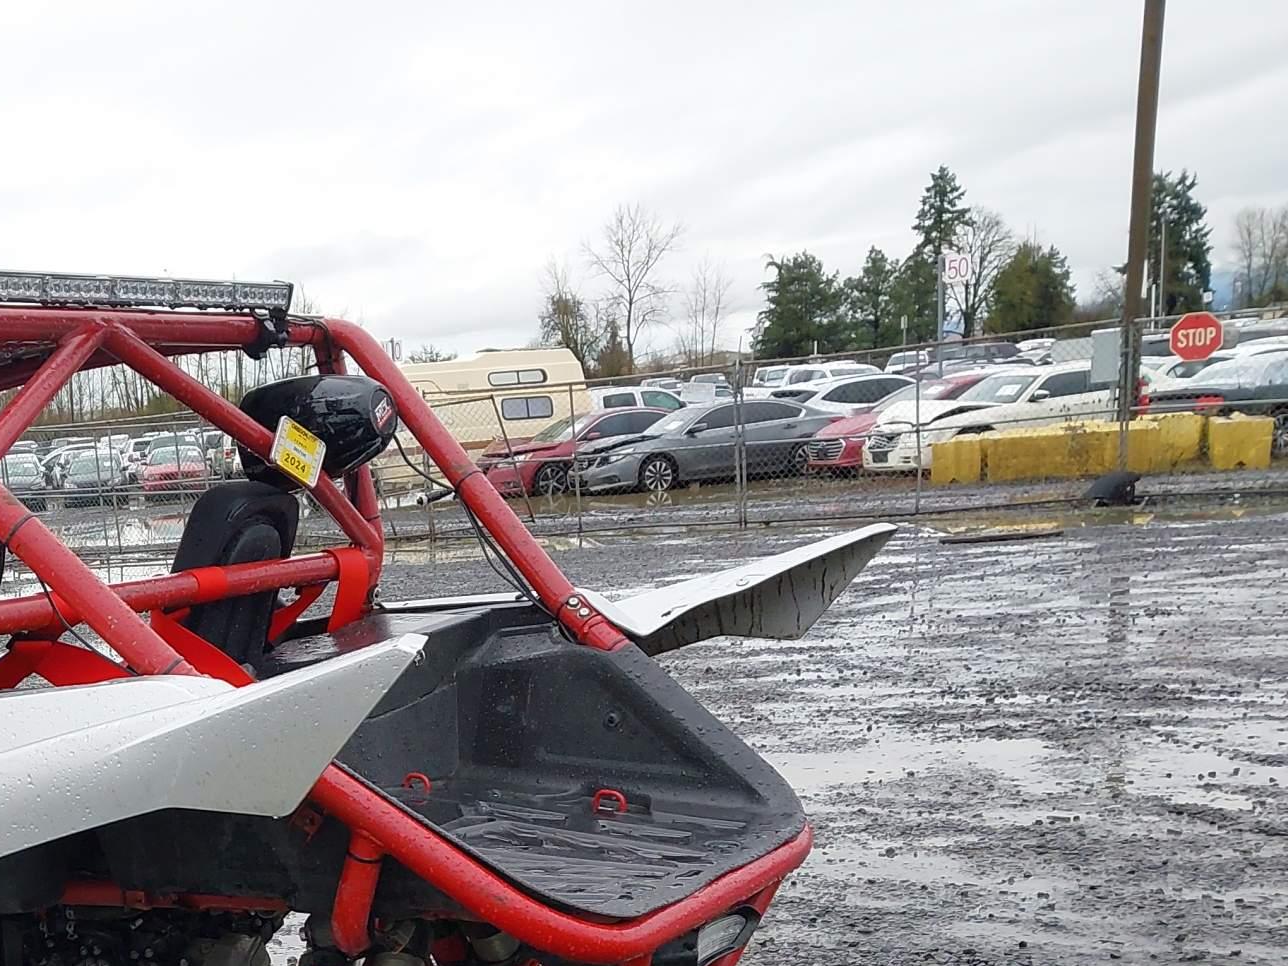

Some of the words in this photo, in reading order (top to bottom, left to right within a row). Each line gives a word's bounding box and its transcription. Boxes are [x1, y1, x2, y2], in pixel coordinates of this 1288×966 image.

[948, 257, 969, 280] 50
[1177, 326, 1217, 348] STOP
[283, 452, 307, 474] 2024
